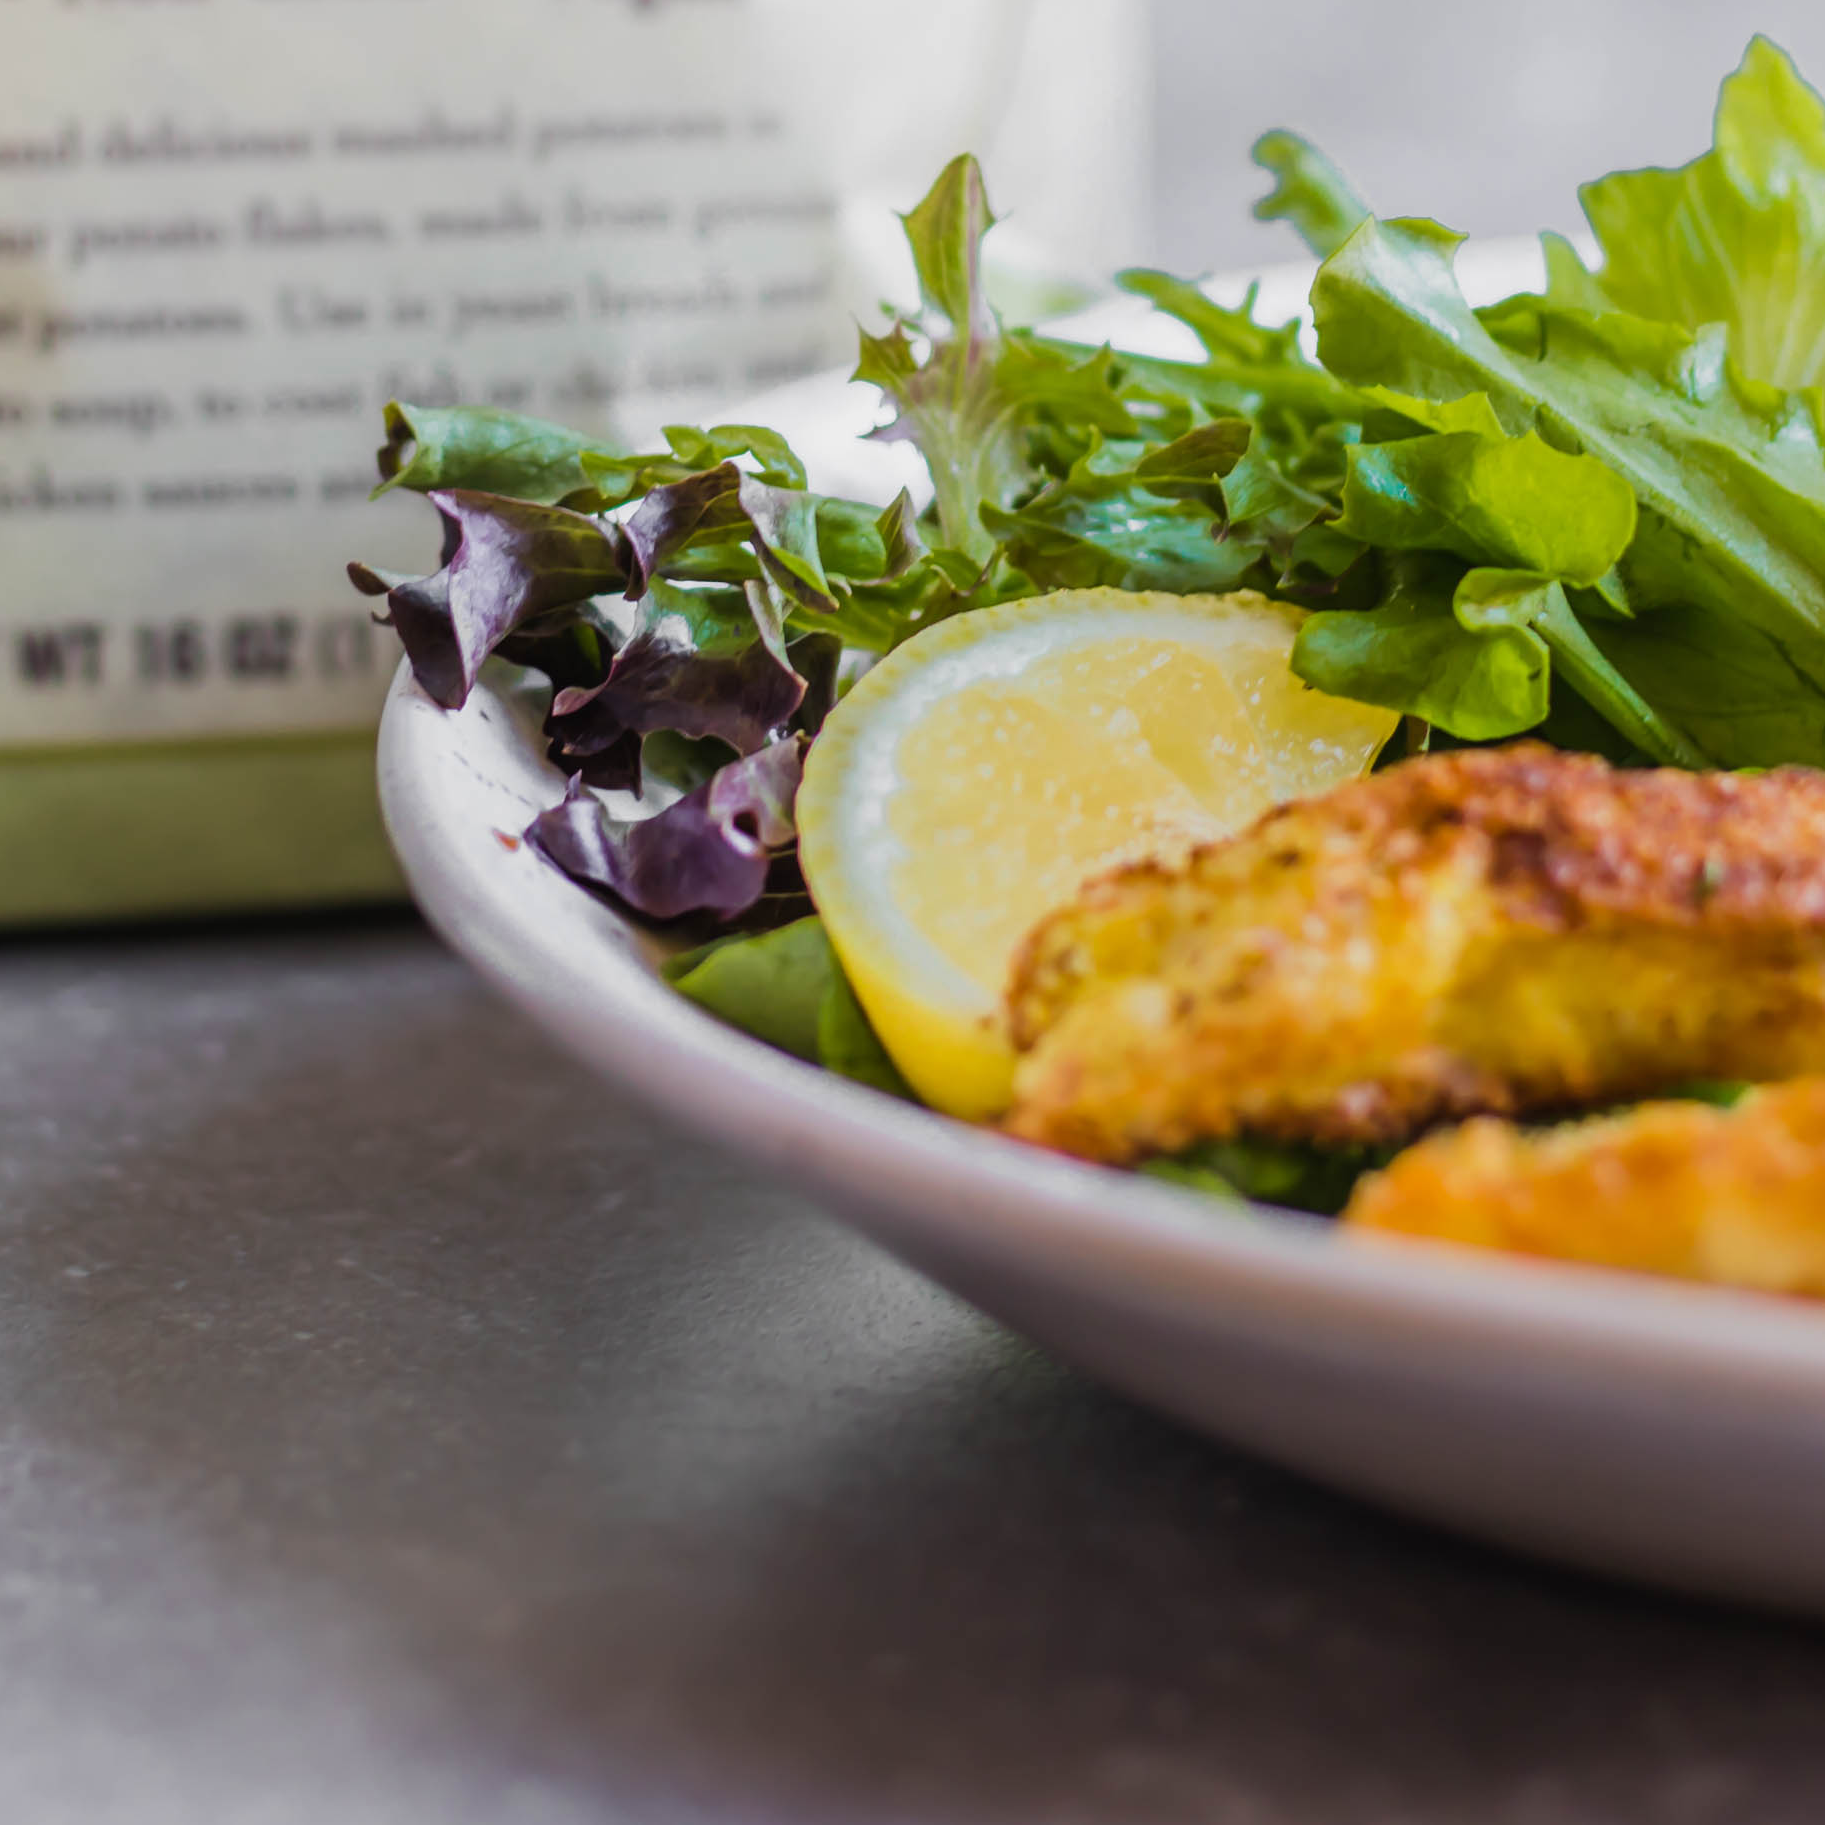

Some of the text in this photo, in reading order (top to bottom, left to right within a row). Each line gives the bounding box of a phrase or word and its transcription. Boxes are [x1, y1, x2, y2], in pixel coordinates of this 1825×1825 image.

[19, 618, 106, 686] WT
[136, 614, 206, 682] 16
[226, 610, 304, 680] OZ
